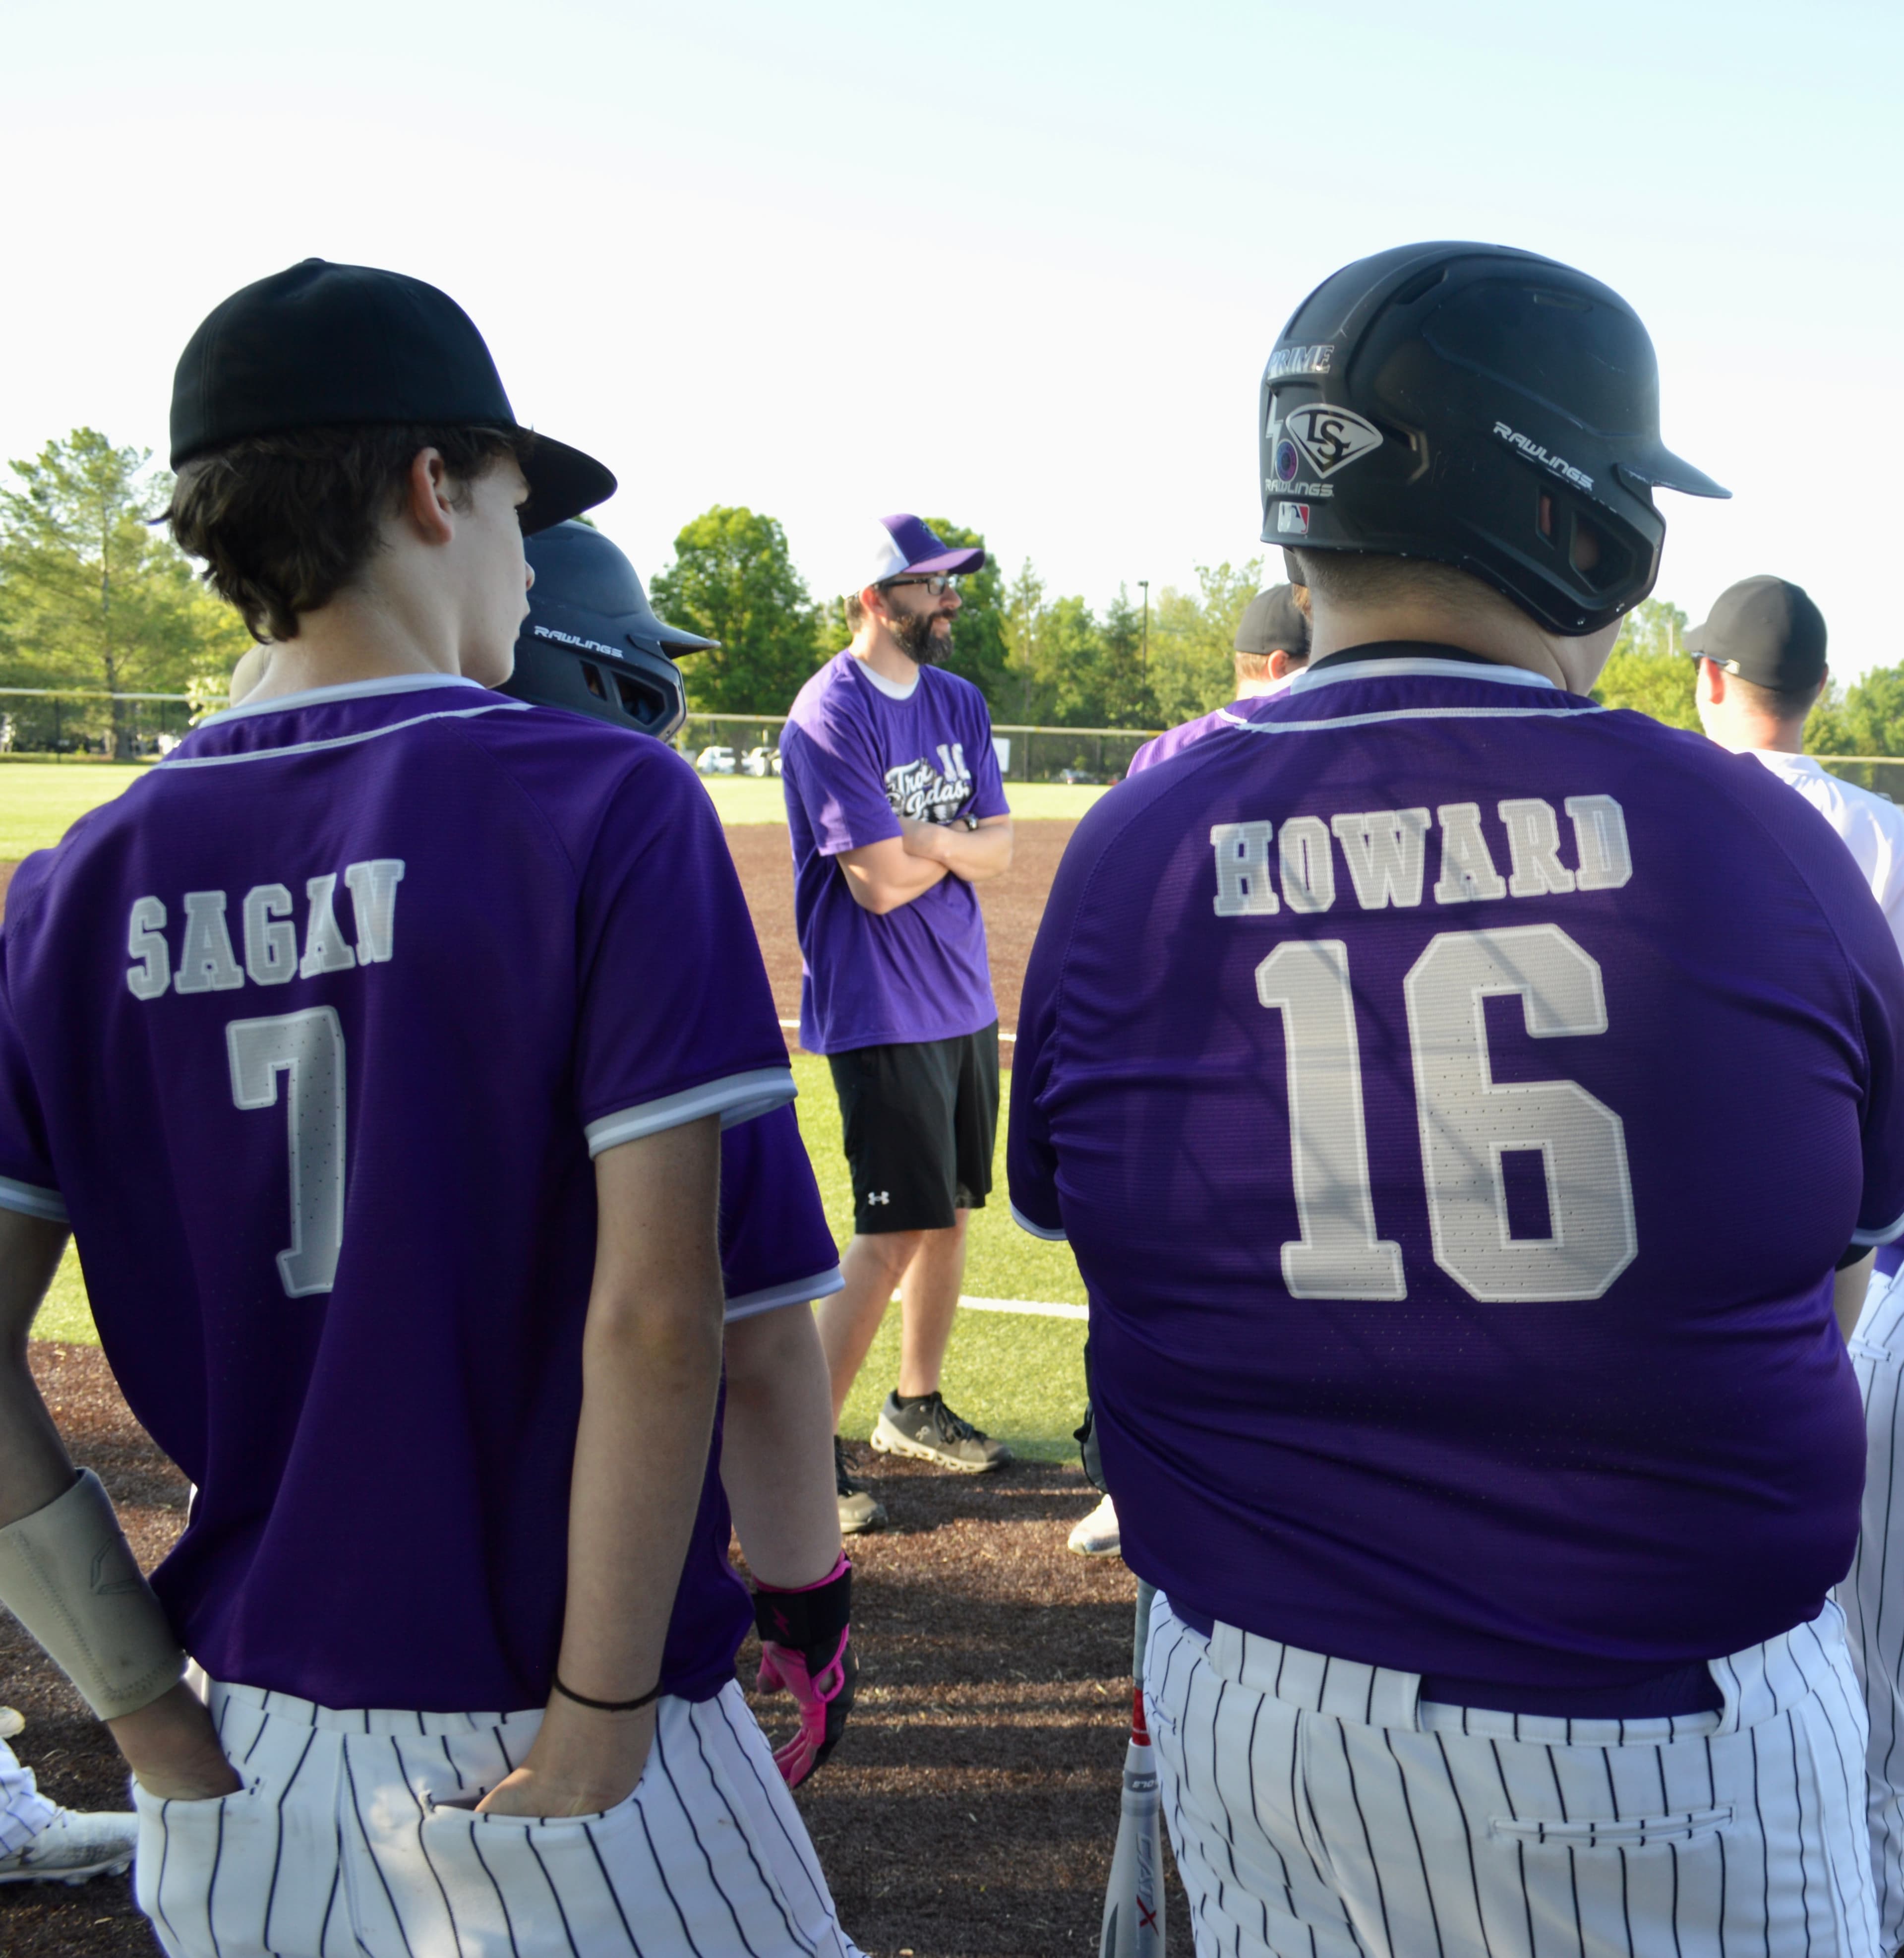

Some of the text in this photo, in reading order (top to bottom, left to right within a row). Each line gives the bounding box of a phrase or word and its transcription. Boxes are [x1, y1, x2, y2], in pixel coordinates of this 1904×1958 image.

[1267, 345, 1334, 380] PRIME
[1265, 479, 1334, 496] RAWLINGS
[1493, 421, 1595, 491] RAWLINGS
[534, 625, 624, 659] RAWLINGS
[1210, 794, 1633, 916] HOWARD
[127, 858, 405, 1000] SAGAN
[225, 1005, 346, 1298] 7
[1254, 923, 1638, 1302] 16
